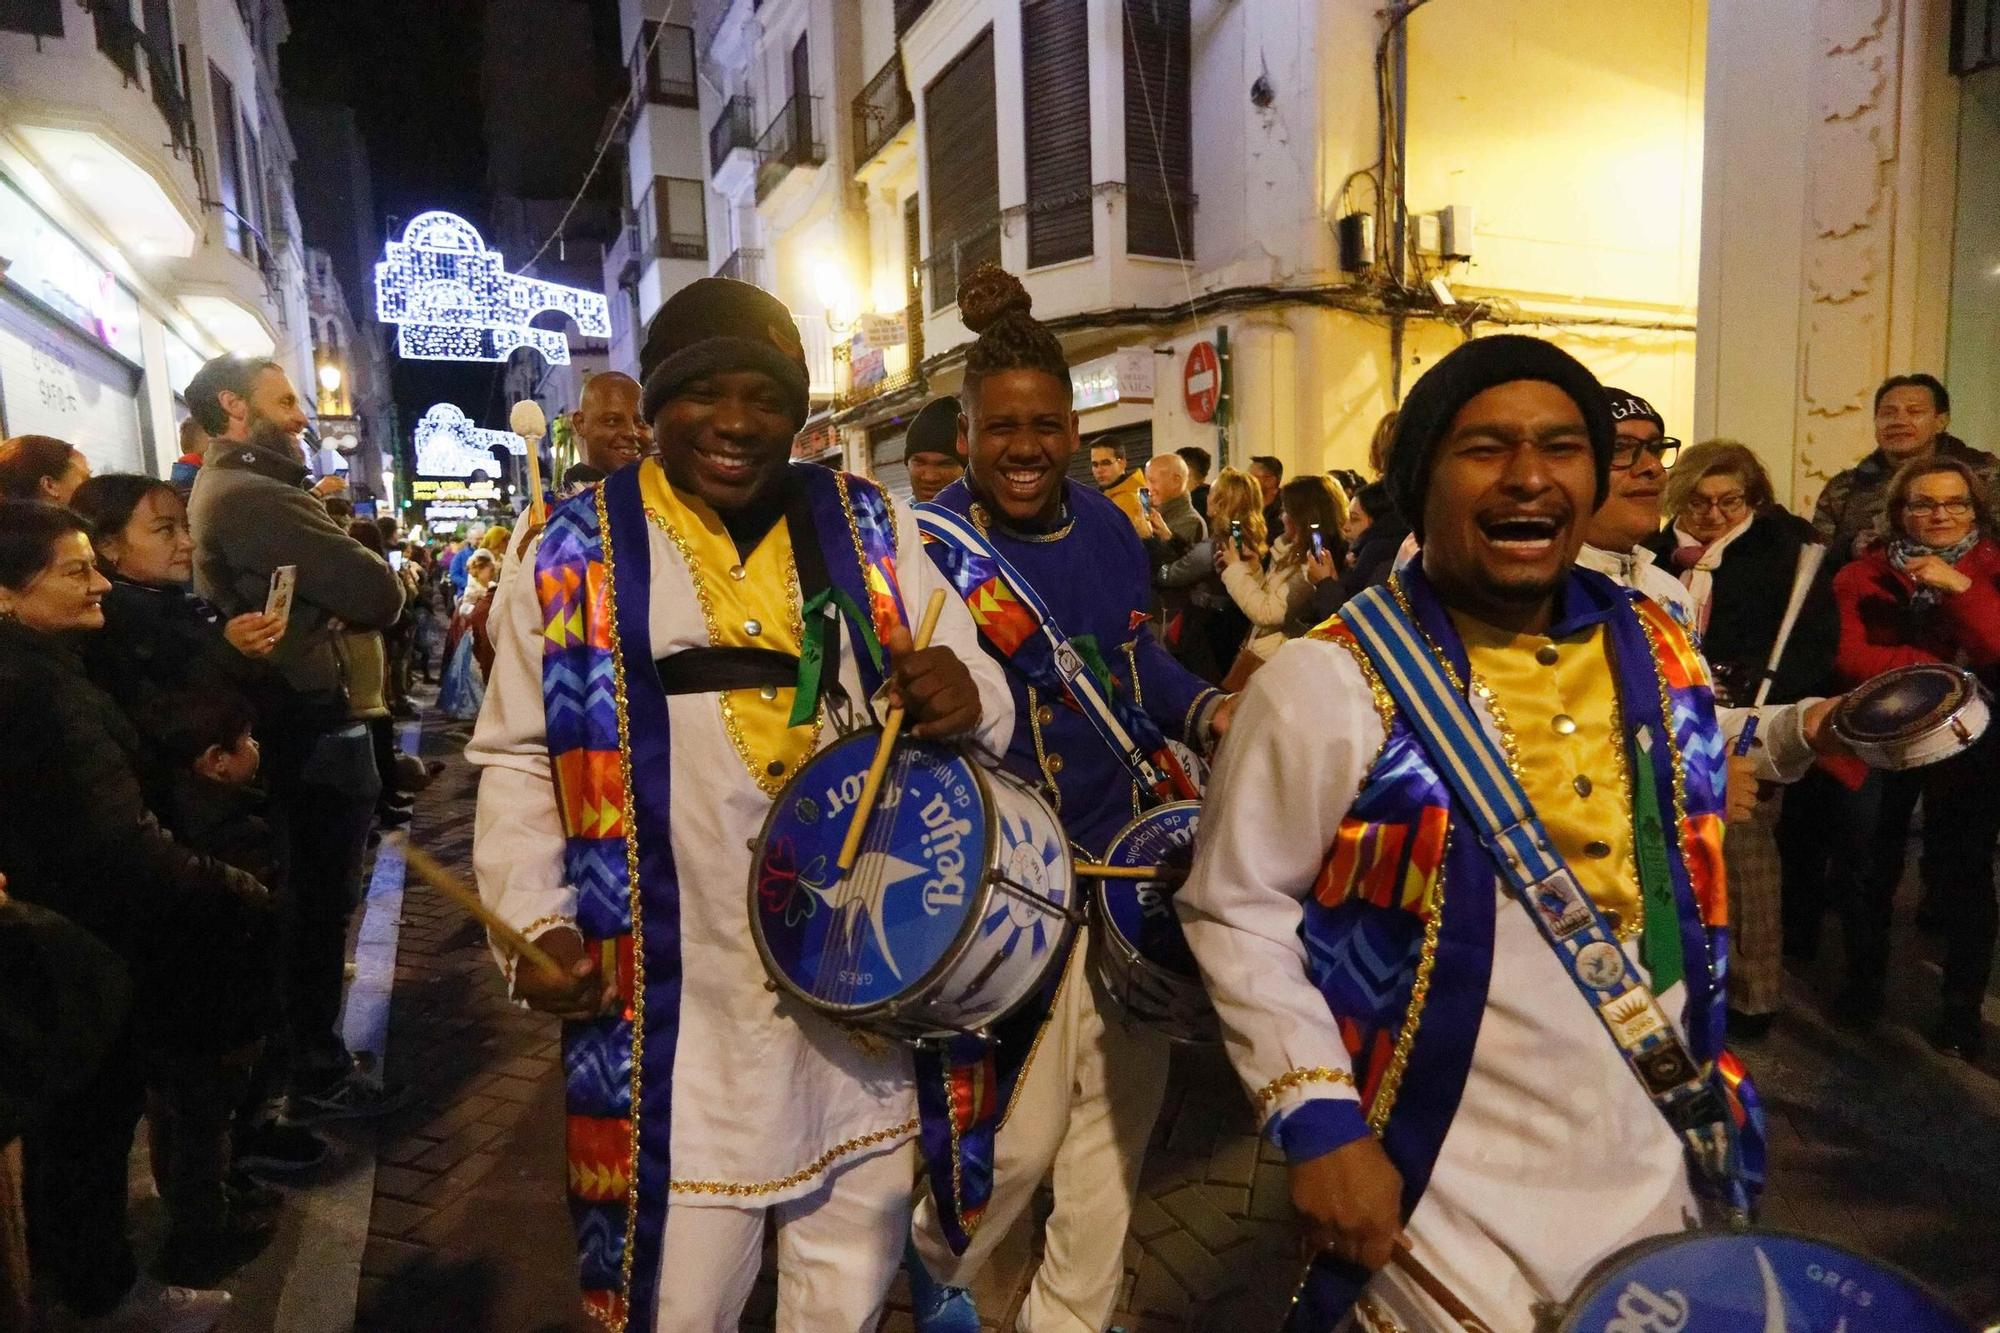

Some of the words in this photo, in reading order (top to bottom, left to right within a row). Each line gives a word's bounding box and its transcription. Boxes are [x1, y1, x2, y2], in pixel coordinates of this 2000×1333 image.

[955, 785, 970, 808] de
[1164, 815, 1181, 827] de
[920, 791, 973, 916] Beija
[839, 970, 873, 986] GRES
[1806, 1263, 1874, 1308] GRES
